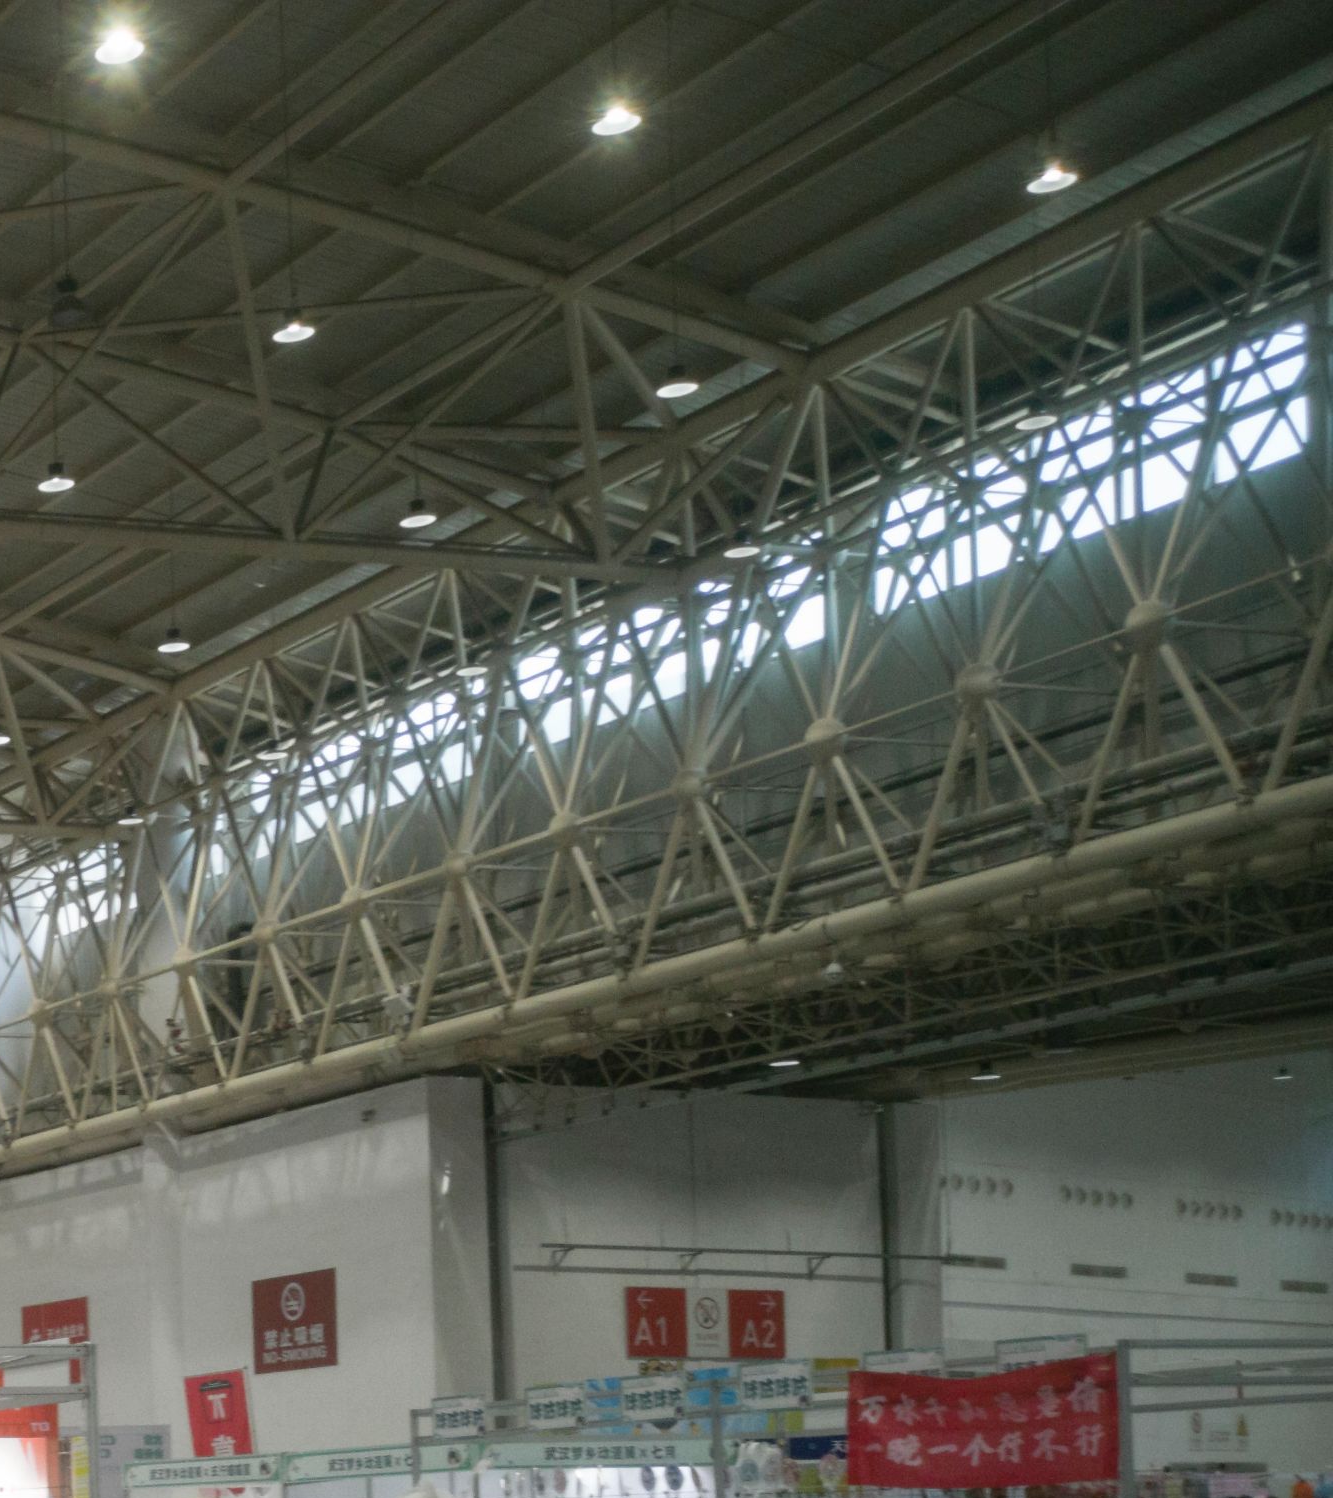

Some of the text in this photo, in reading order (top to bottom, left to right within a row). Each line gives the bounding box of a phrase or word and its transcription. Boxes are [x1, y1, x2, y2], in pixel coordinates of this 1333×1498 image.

[263, 1322, 325, 1351] 禁止吸烟
[634, 1316, 669, 1347] A1
[741, 1319, 777, 1349] A2
